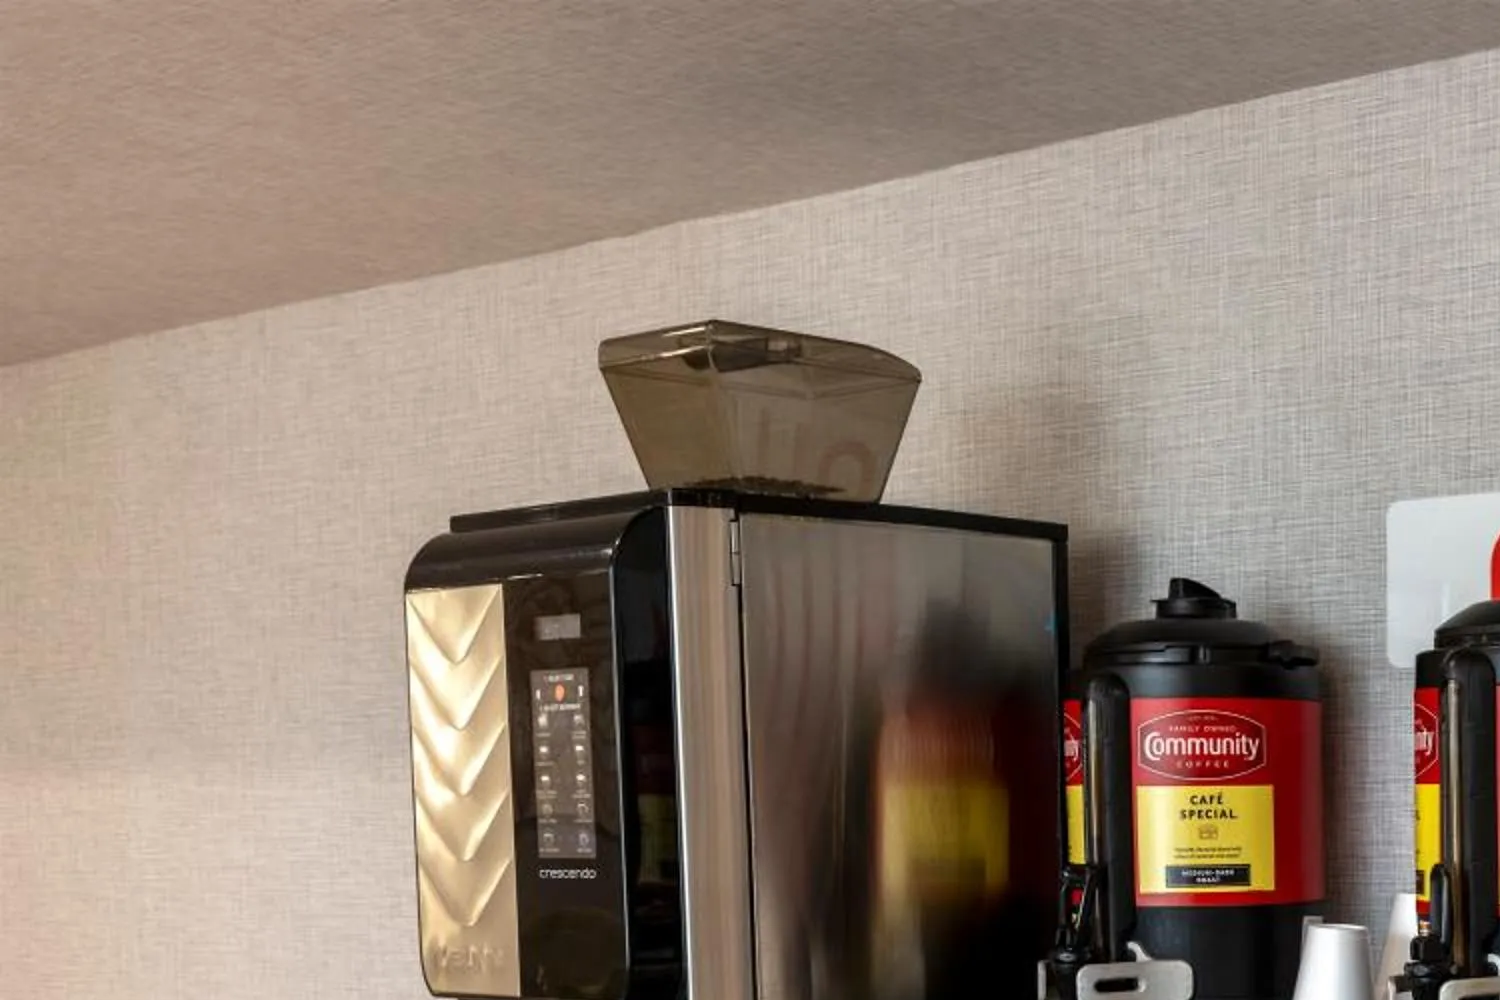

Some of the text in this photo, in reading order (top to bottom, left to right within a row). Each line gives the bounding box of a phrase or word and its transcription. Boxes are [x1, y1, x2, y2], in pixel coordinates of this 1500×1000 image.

[1145, 731, 1260, 761] Community
[1190, 792, 1224, 805] CAFÉ
[1179, 809, 1237, 820] SPECIAL
[539, 867, 597, 879] crescendo
